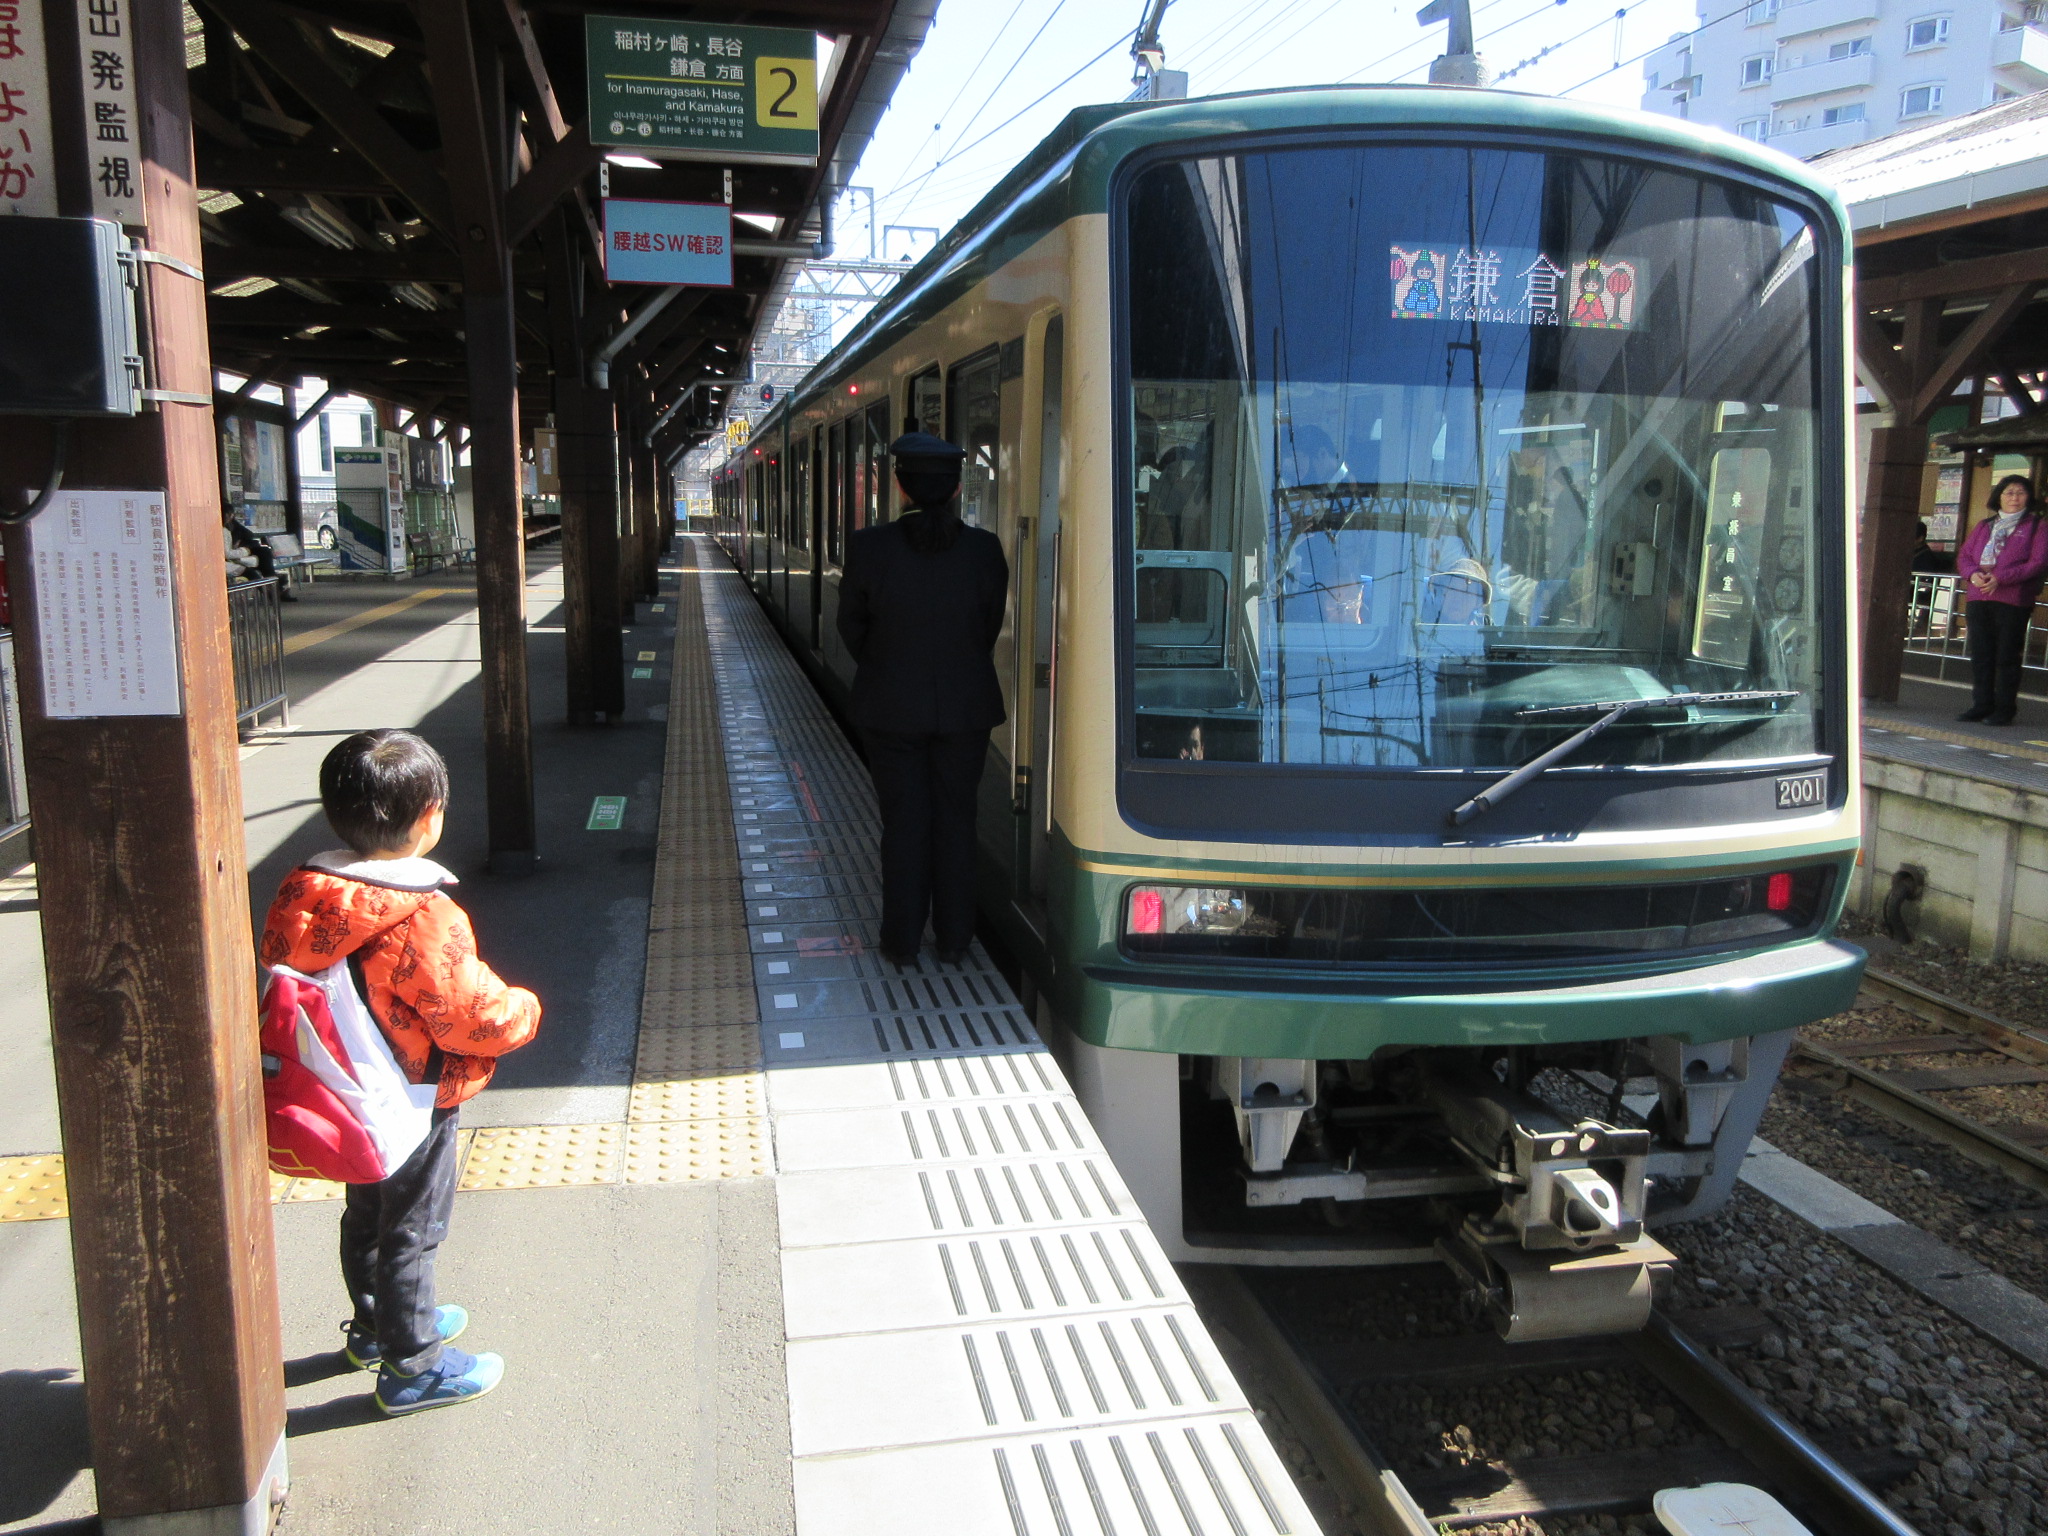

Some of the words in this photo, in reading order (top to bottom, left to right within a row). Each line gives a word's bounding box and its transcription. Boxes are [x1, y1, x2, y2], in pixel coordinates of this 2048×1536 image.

[670, 57, 706, 78] 鎌倉
[716, 64, 743, 80] 方面
[89, 0, 134, 199] 出発監視
[607, 83, 623, 93] for
[626, 84, 709, 99] Inamuragasaki,
[712, 87, 744, 101] Hase,
[769, 67, 798, 118] 2
[666, 101, 686, 111] and
[689, 101, 744, 115] Kamakura
[613, 231, 723, 255] 腰越SW確認
[1448, 248, 1567, 310] 鎌倉
[1450, 305, 1560, 327] KAMAKURA
[1780, 778, 1820, 805] 2001
